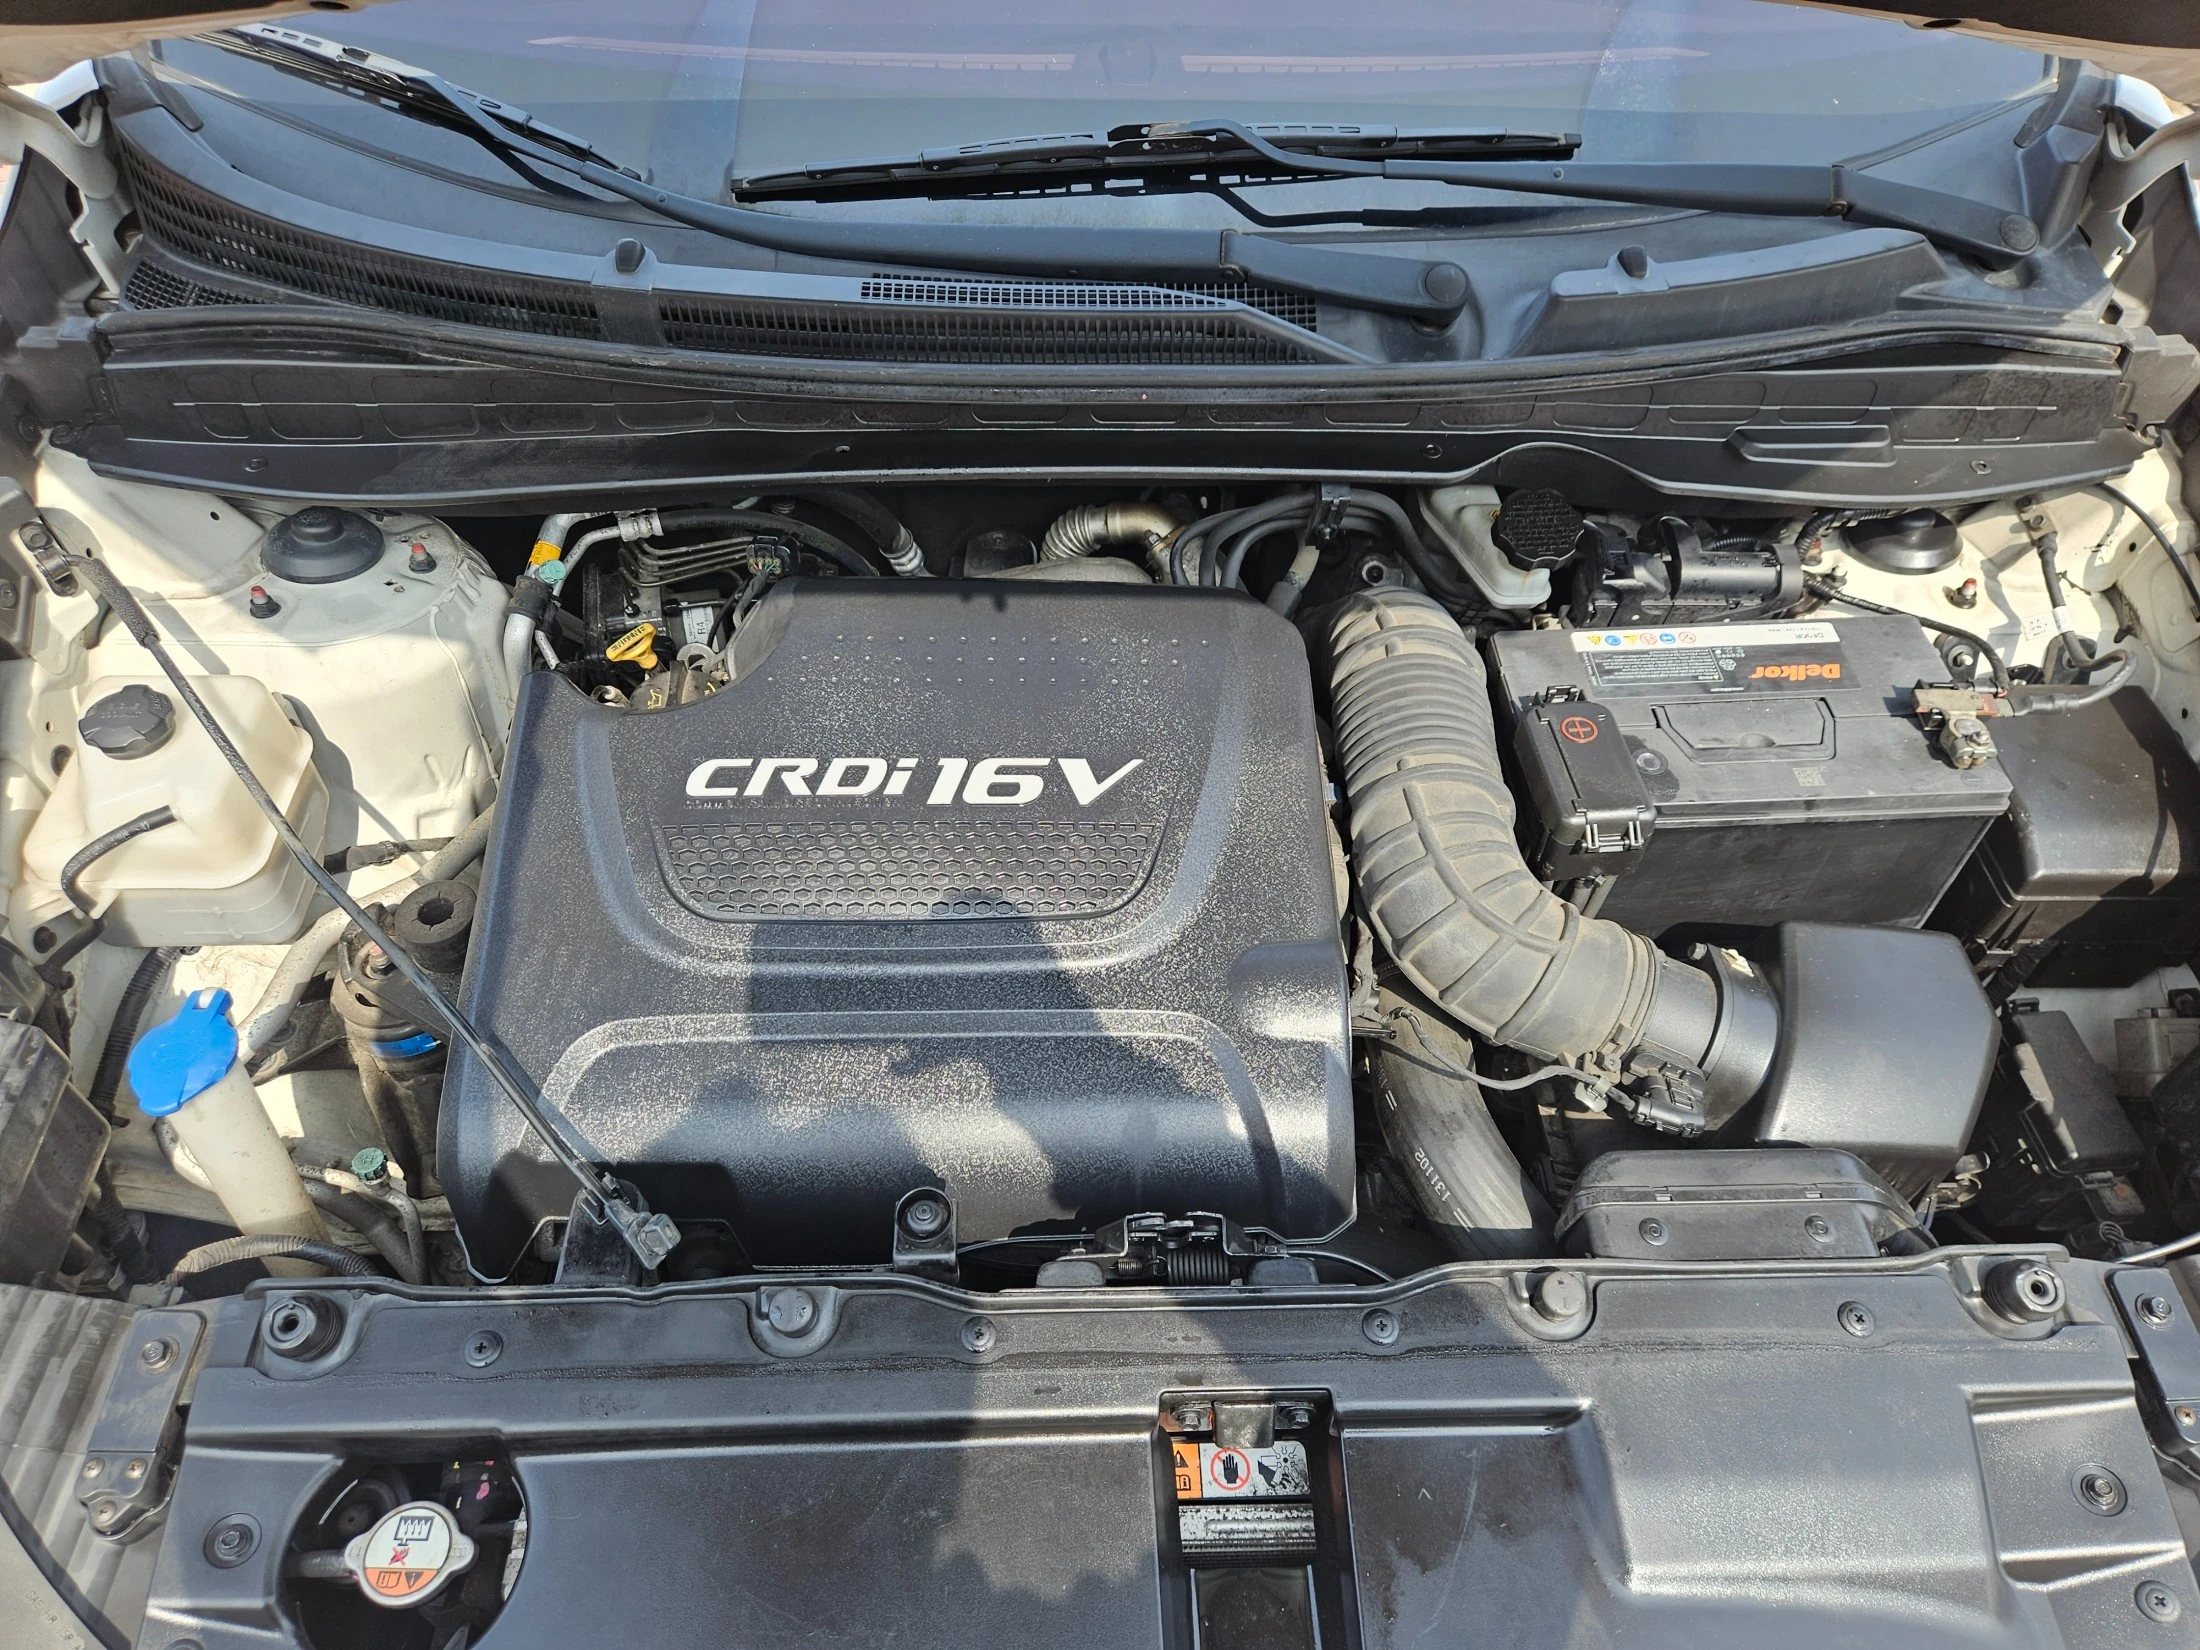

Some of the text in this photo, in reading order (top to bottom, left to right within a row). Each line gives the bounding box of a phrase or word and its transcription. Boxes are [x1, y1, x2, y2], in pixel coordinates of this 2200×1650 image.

[1750, 663, 1841, 681] Delkor
[685, 757, 1145, 807] CRDi 16V
[1414, 1147, 1451, 1202] 131102
[25, 1590, 46, 1610] SAE
